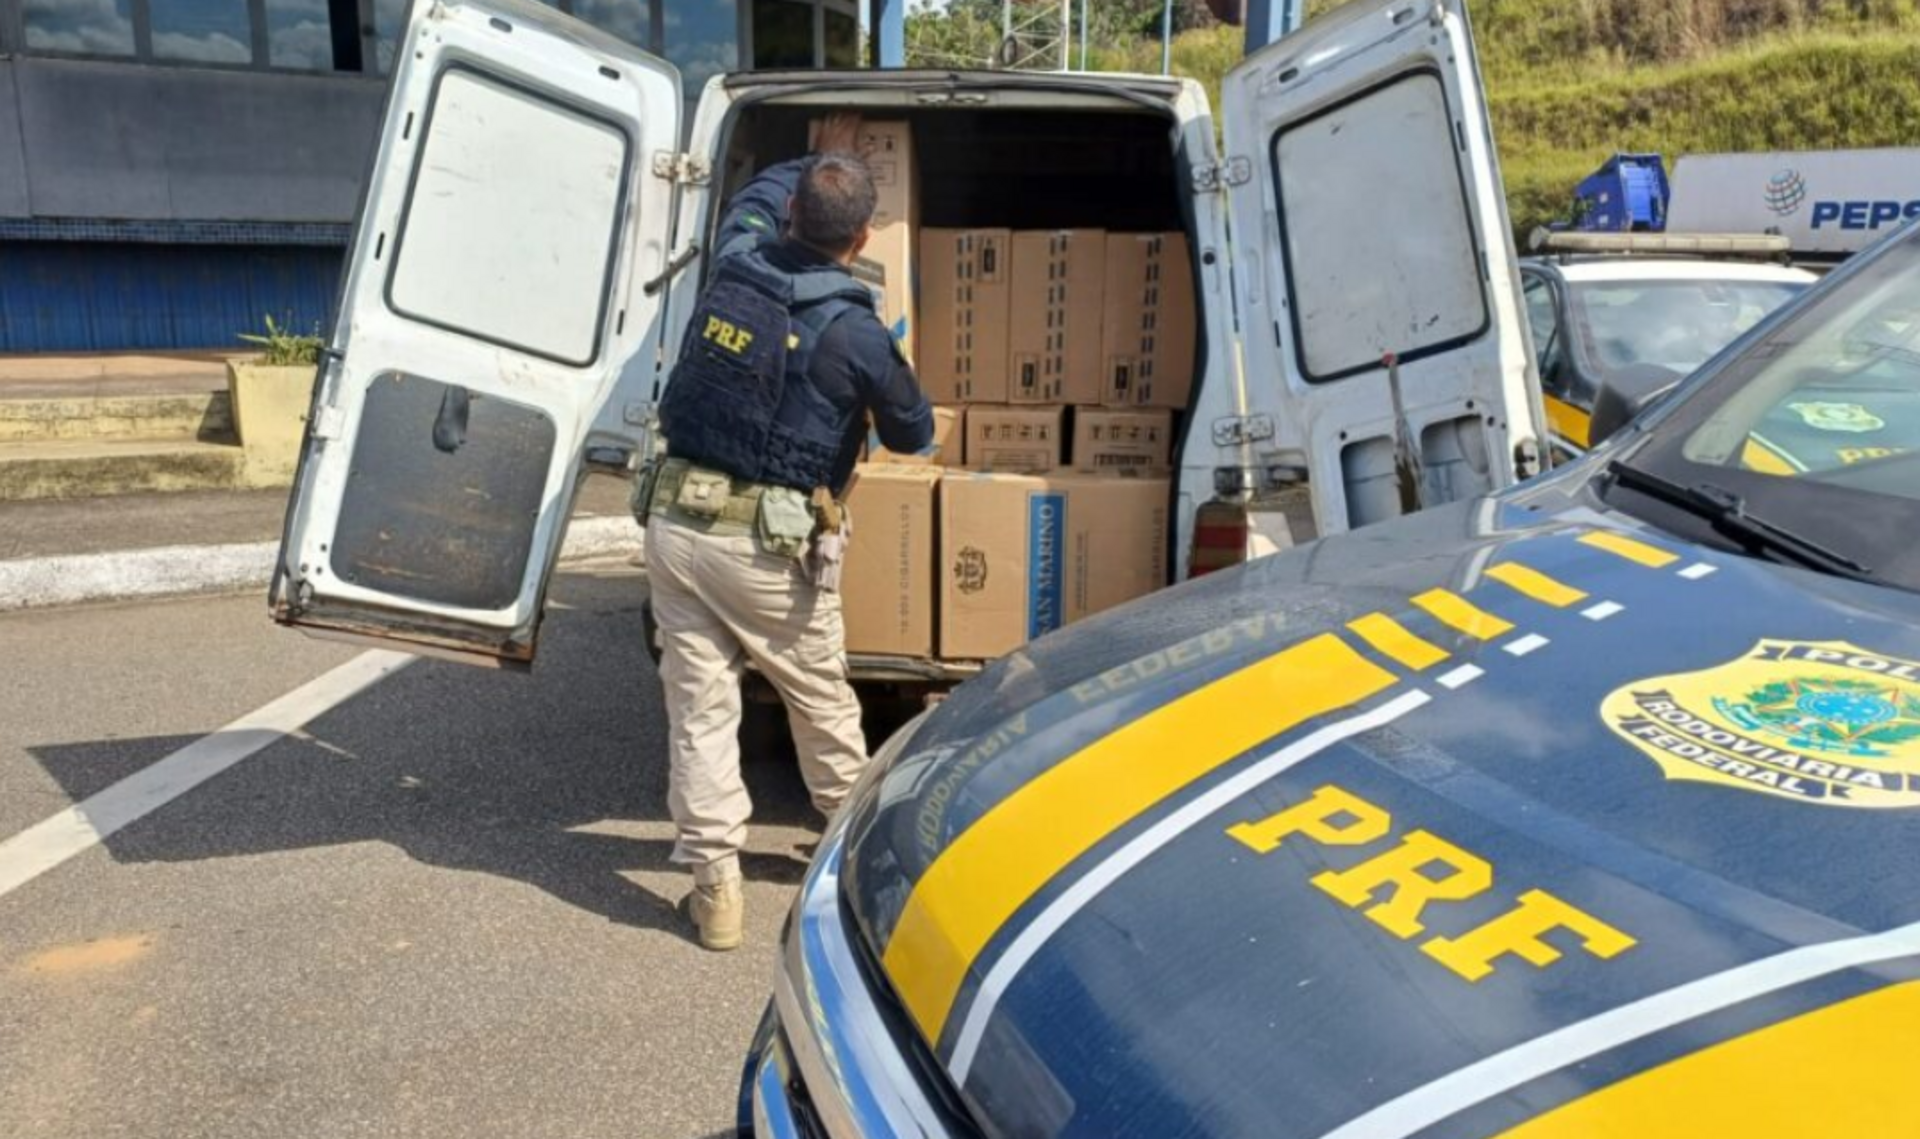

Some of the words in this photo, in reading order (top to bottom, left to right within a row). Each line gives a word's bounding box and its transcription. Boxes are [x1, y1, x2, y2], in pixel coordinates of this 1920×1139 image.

[702, 316, 753, 354] PRF
[1037, 503, 1055, 590] MARINO
[1631, 723, 1806, 794] FEDERAL
[1643, 699, 1885, 788] RODOVIARIA
[1224, 783, 1639, 982] PRF
